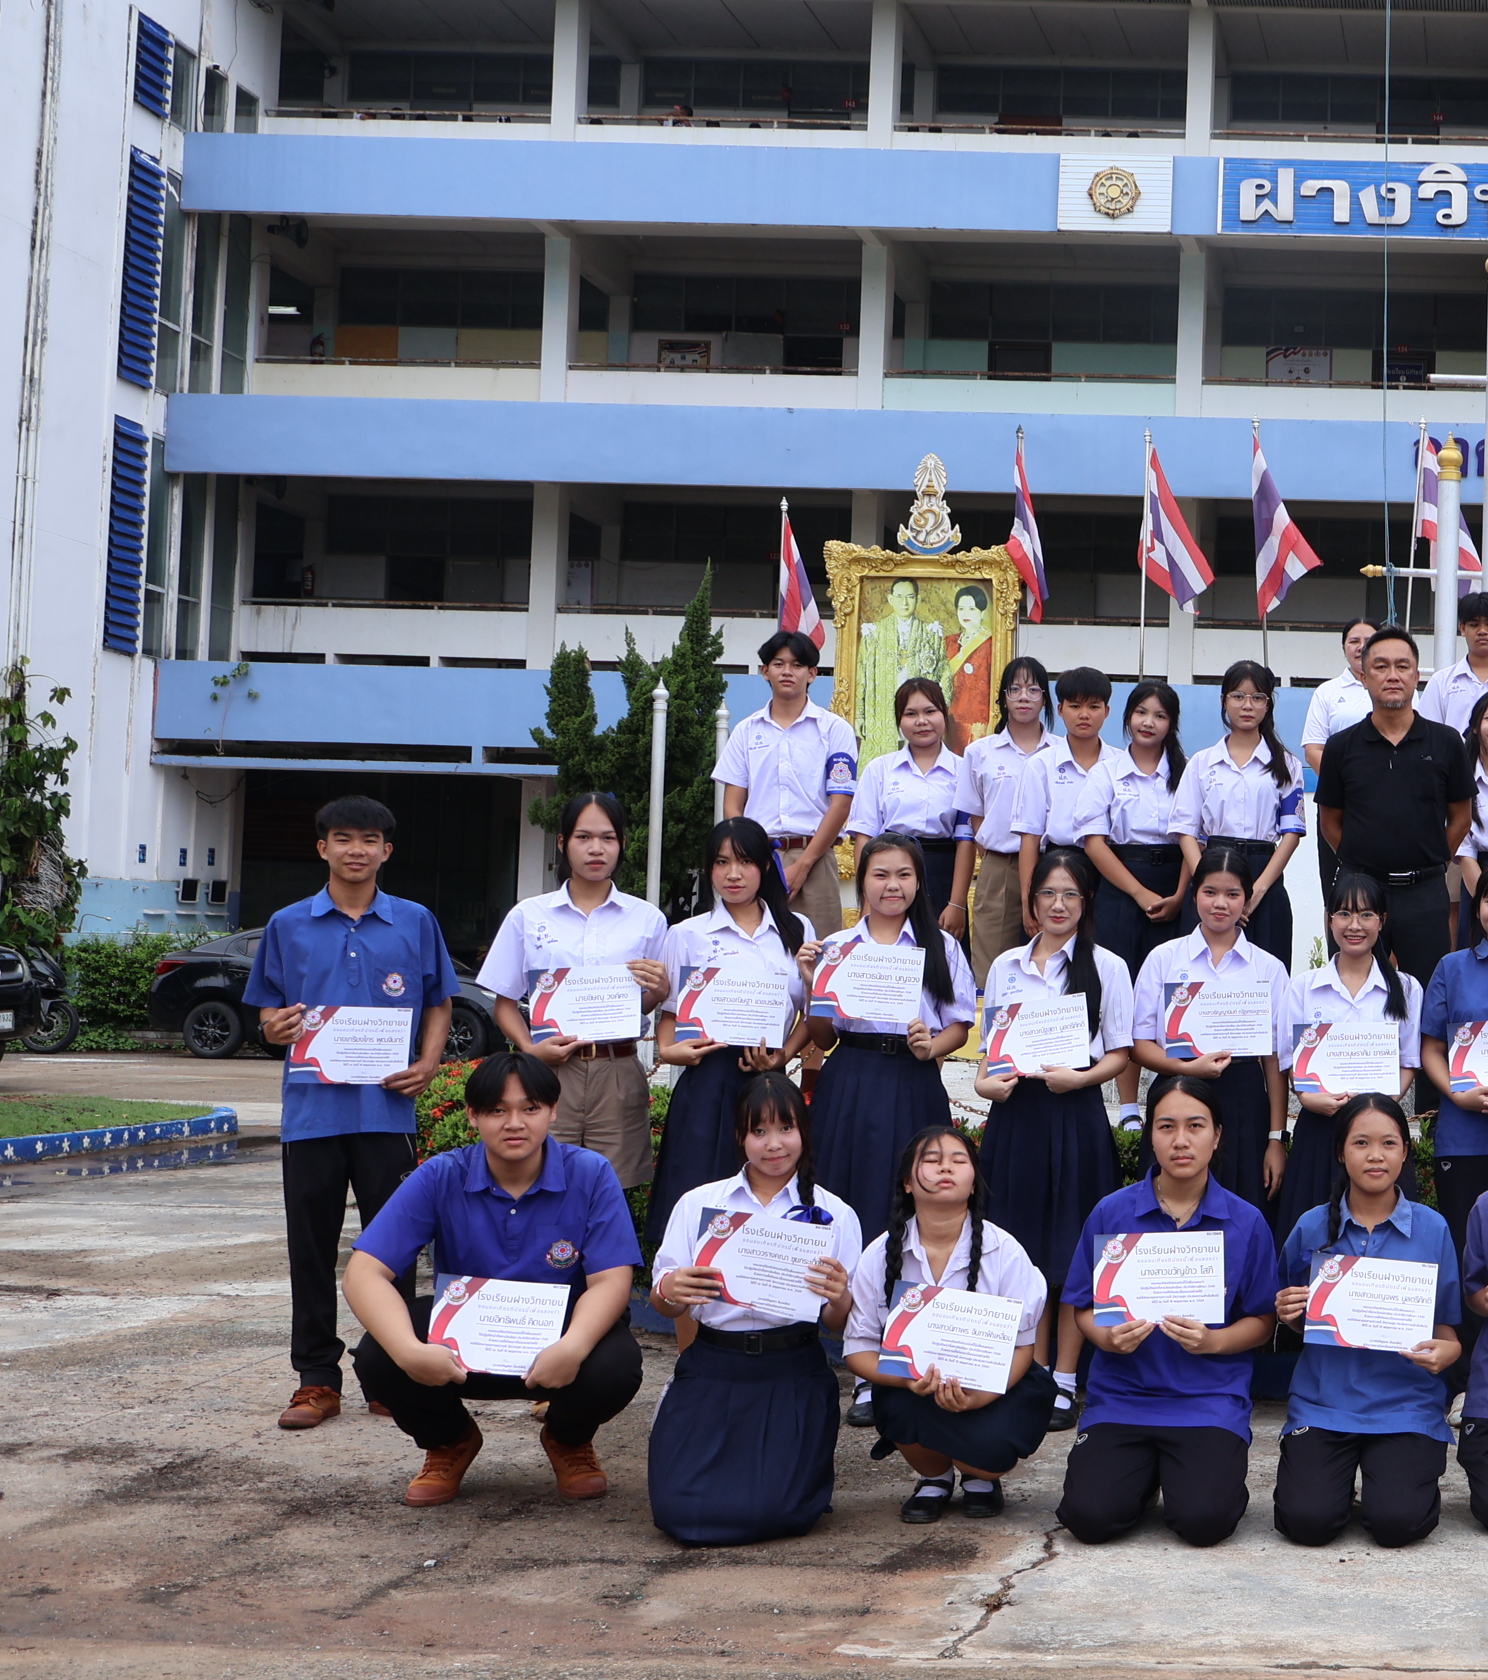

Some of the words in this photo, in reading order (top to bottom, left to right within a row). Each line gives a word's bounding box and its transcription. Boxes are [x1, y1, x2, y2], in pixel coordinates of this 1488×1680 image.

[850, 952, 921, 965] โรงเรียนฝางวิทยายน
[565, 976, 633, 986] โรงเรียนฝางวิทยาย
[713, 978, 785, 990] โรงเรียนฝางวิทยายน
[1198, 991, 1268, 999] โรงเรียนฝางวิทยายน
[1018, 1005, 1084, 1021] โรงเรียนฝางวิทยายน
[332, 1017, 408, 1026] โรงเรียนฝางวิทยายน
[1326, 1033, 1396, 1041] โรงเรียนฝางวิทยายน
[742, 1225, 826, 1247] โรงเรียนฝางวิทยายน
[1135, 1245, 1220, 1255] โรงเรียนฝางวิทยายน
[1141, 1266, 1197, 1276] นางสาวขวัญข้าว
[1351, 1269, 1433, 1285] โรงเรียนฝางวิทยายน
[478, 1291, 564, 1306] โรงเรียนฝางวิทยายน
[1349, 1291, 1399, 1302] นางสาวเบญจพร
[932, 1299, 1017, 1321] โรงเรียนฝางวิทยายน
